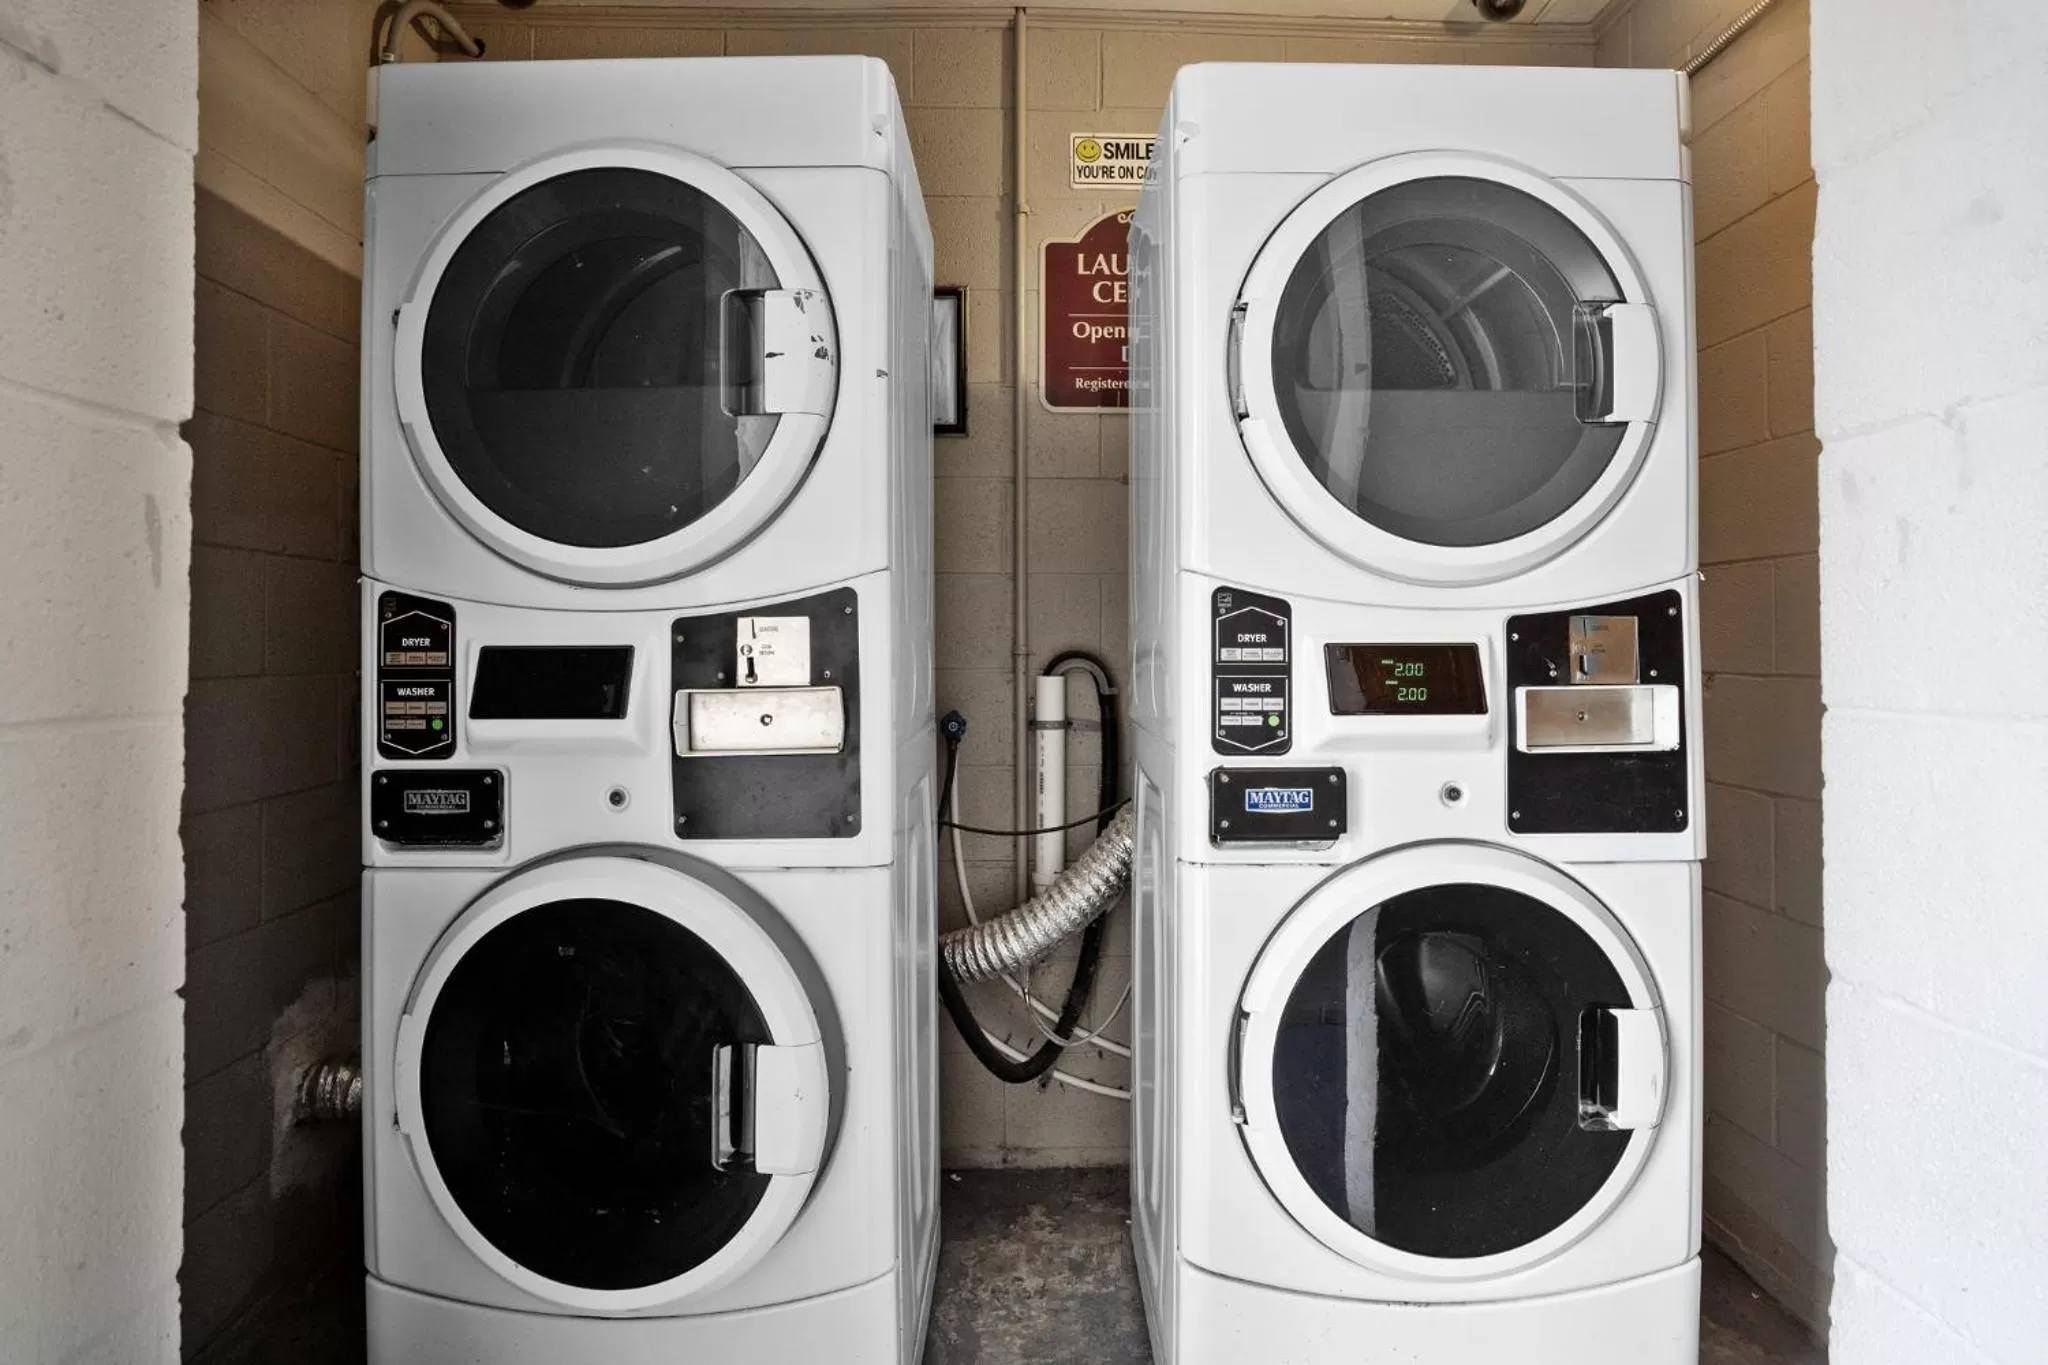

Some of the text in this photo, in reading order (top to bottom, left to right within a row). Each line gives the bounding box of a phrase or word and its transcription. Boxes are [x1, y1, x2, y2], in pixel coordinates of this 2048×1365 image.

[1103, 142, 1154, 160] SMILE
[1076, 165, 1115, 179] YOU'RE
[1118, 166, 1134, 179] ON
[1072, 321, 1126, 344] Open
[401, 637, 431, 647] DRYER
[1237, 633, 1268, 643] DRYER
[1394, 662, 1424, 677] 2.00
[396, 687, 436, 697] WASHER
[1232, 683, 1272, 693] WASHER
[1397, 687, 1427, 701] 2.00
[407, 793, 465, 805] MAYTAG
[1249, 791, 1310, 804] MAYTAG
